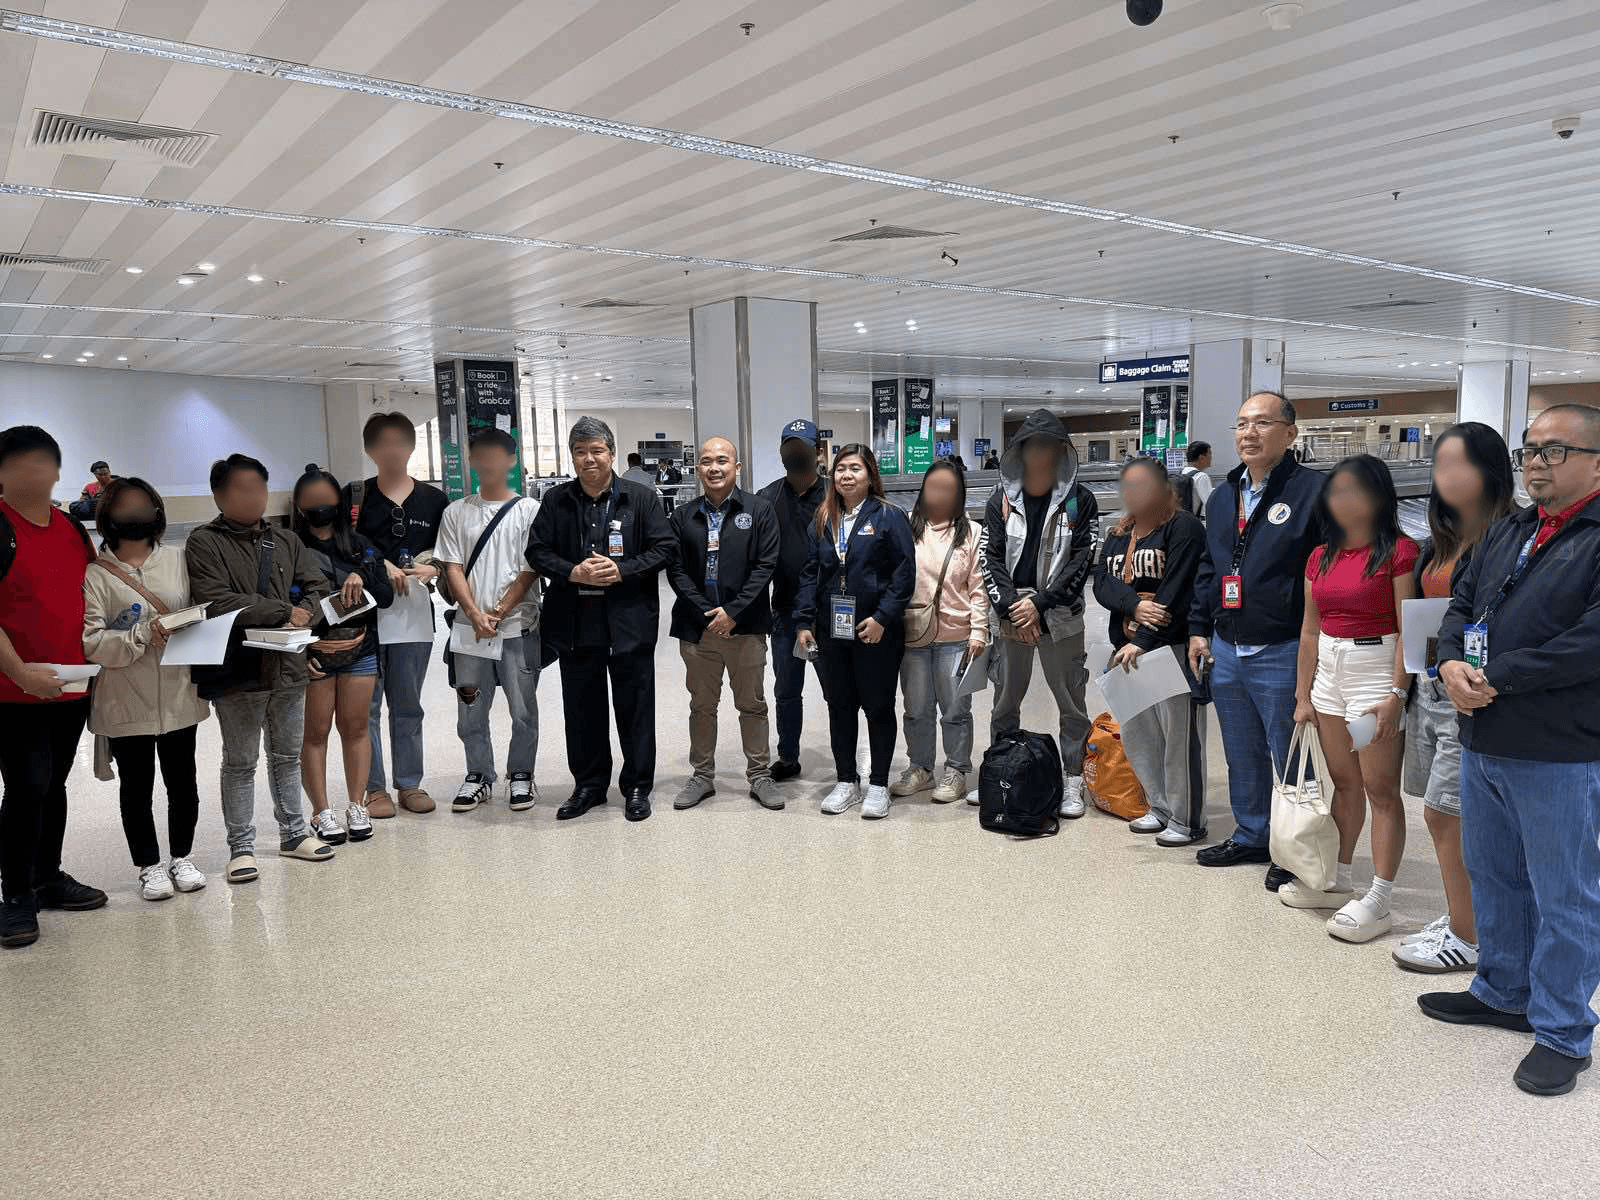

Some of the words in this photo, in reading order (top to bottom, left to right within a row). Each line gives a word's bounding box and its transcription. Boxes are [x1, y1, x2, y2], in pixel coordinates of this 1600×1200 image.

[1119, 367, 1150, 377] Baggage
[1151, 364, 1172, 373] Claim
[478, 397, 511, 405] GrabCar
[979, 524, 1001, 604] CALIFORNIA
